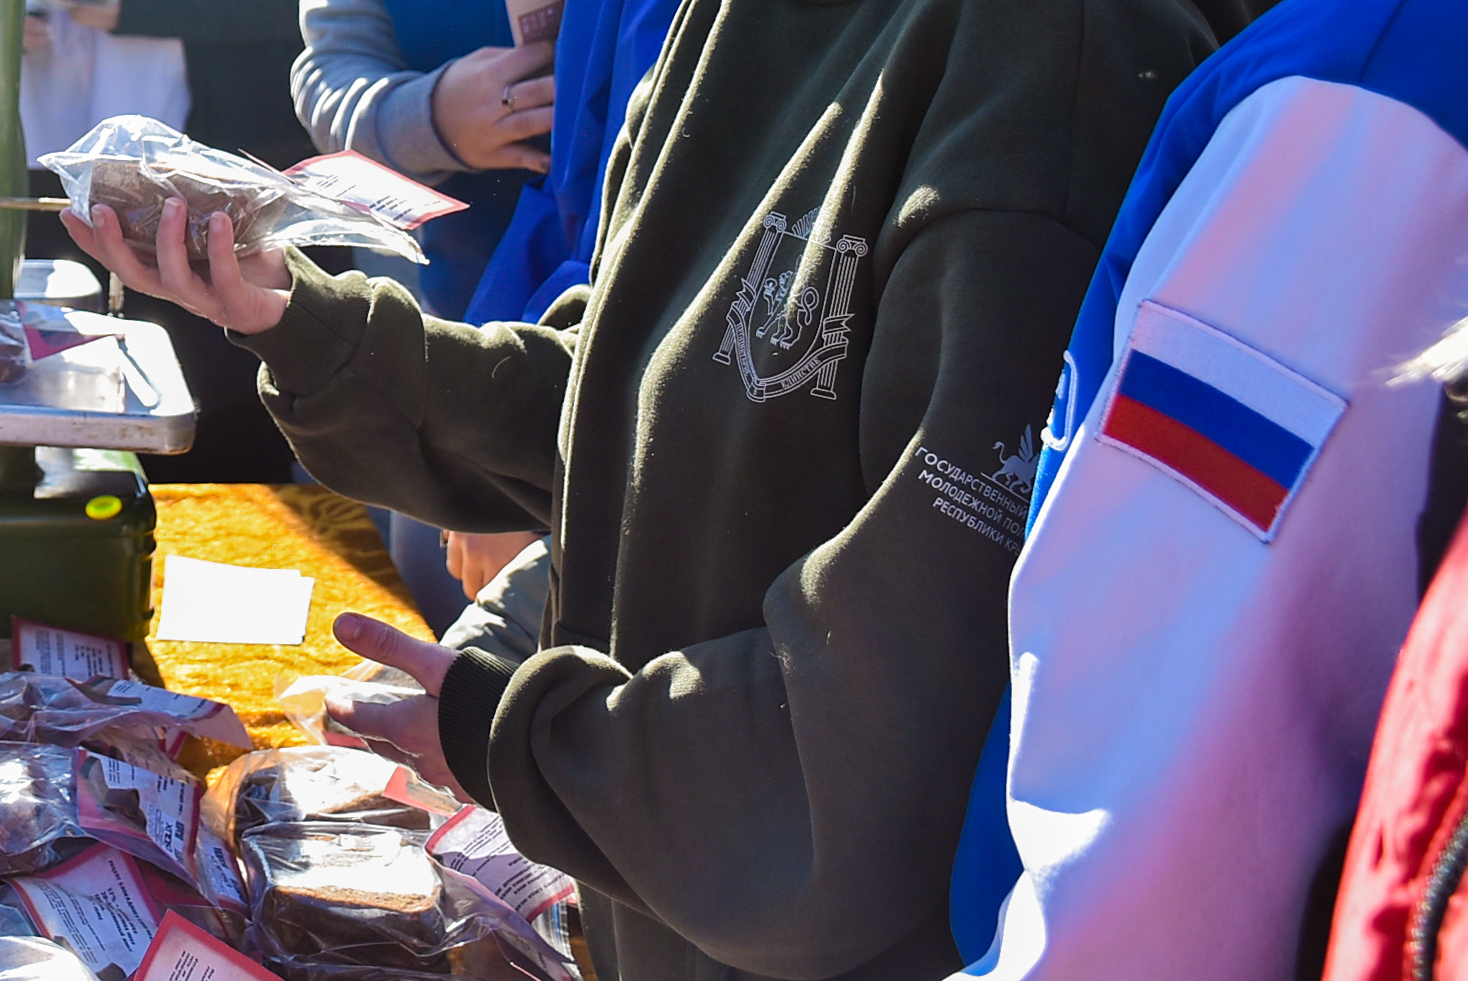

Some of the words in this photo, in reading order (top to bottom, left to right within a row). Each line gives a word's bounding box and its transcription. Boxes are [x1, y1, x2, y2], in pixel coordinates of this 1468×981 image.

[915, 446, 1028, 519] ГОСУДАРСТВЕННЫЙ
[918, 469, 1003, 524] МОЛОДЕЖНОЙ
[933, 497, 1004, 544] РЕСПУБЛИКИ
